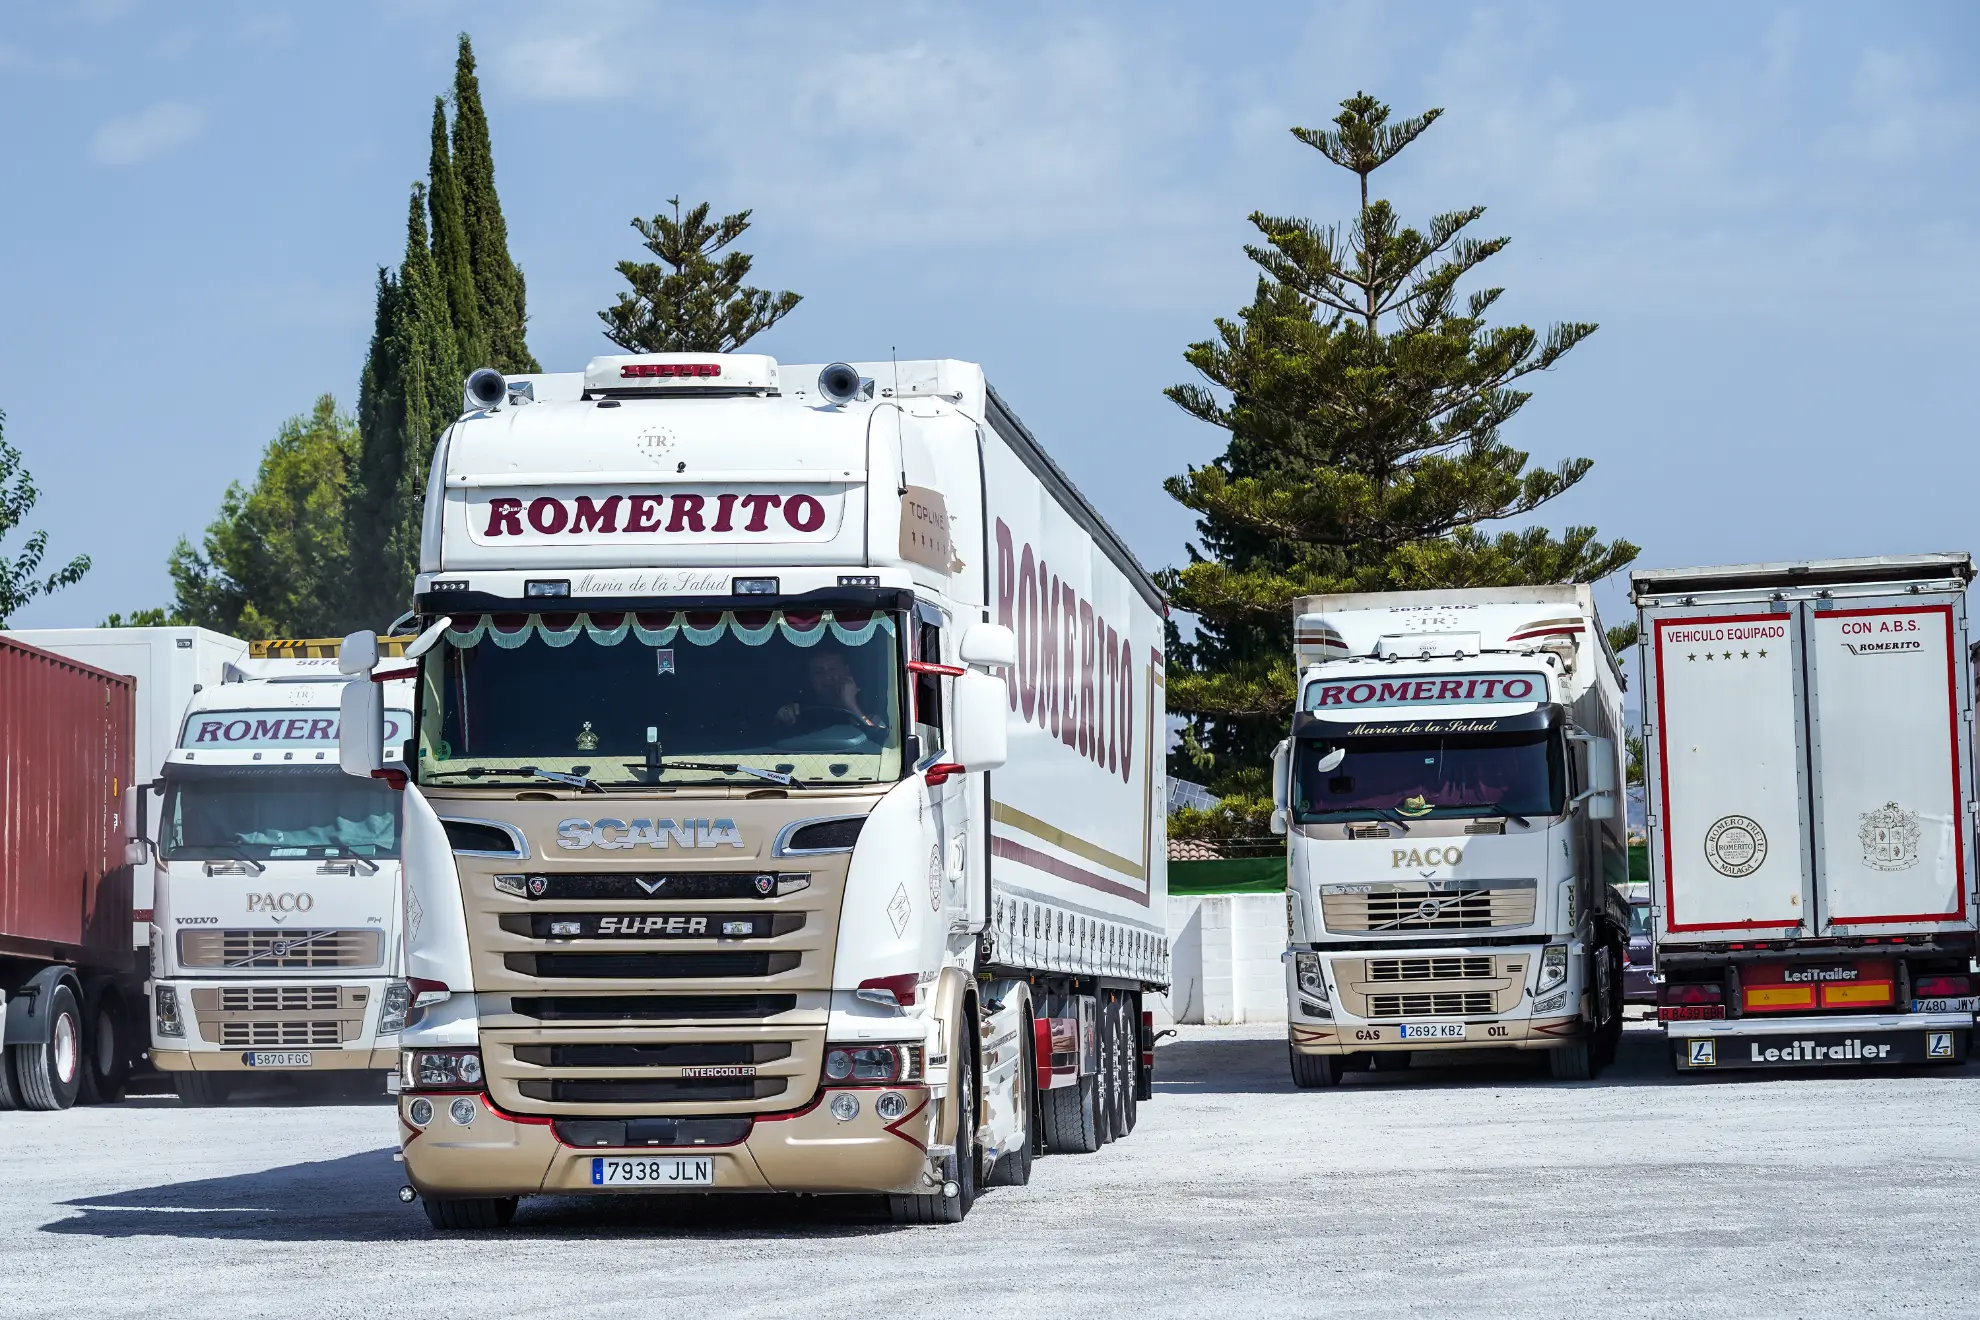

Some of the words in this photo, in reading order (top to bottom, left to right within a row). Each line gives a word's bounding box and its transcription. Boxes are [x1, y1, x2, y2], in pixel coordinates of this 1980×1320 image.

[645, 435, 667, 446] TR
[484, 494, 826, 537] ROMERITO
[909, 501, 945, 531] TOPLINE
[628, 574, 647, 592] de
[673, 571, 730, 592] Salud
[1667, 629, 1724, 643] VEHICULO
[1727, 626, 1785, 640] EQUIPADO
[1841, 622, 1872, 635] CON
[1880, 620, 1921, 633] A.B.S.
[995, 516, 1133, 784] ROMERITO
[1860, 641, 1921, 651] ROMERITO
[1317, 679, 1533, 706] ROMERITO
[195, 718, 399, 742] ROMERO
[1348, 723, 1399, 736] Maria
[1401, 722, 1421, 734] de
[1424, 721, 1443, 732] la
[1446, 720, 1498, 732] Salud
[556, 817, 745, 850] SCANIA
[1709, 818, 1744, 842] ROMERO
[1745, 821, 1765, 853] PRETEL
[1391, 846, 1462, 869] PACO
[1719, 863, 1754, 875] MALAGA
[245, 892, 314, 913] PACO
[1567, 885, 1576, 927] VOLVO
[175, 916, 219, 925] VOLVO
[366, 916, 382, 924] FH
[1286, 895, 1294, 937] VOLVO
[598, 917, 707, 934] SUPER
[149, 931, 157, 973] VOLVO
[1784, 967, 1858, 982] LeciTrailer
[1918, 1000, 1947, 1012] 7480
[1954, 999, 1975, 1011] JWY
[1355, 1030, 1381, 1040] GAS
[1408, 1025, 1437, 1037] 2692
[1441, 1025, 1463, 1036] KBZ
[1488, 1026, 1509, 1037] OIL
[256, 1052, 285, 1065] 5870
[287, 1052, 309, 1064] FGC
[1751, 1039, 1891, 1062] LeciTrailer
[682, 1067, 756, 1077] INTERCOOLER
[608, 1162, 660, 1181] 7938
[669, 1161, 707, 1181] JLN
